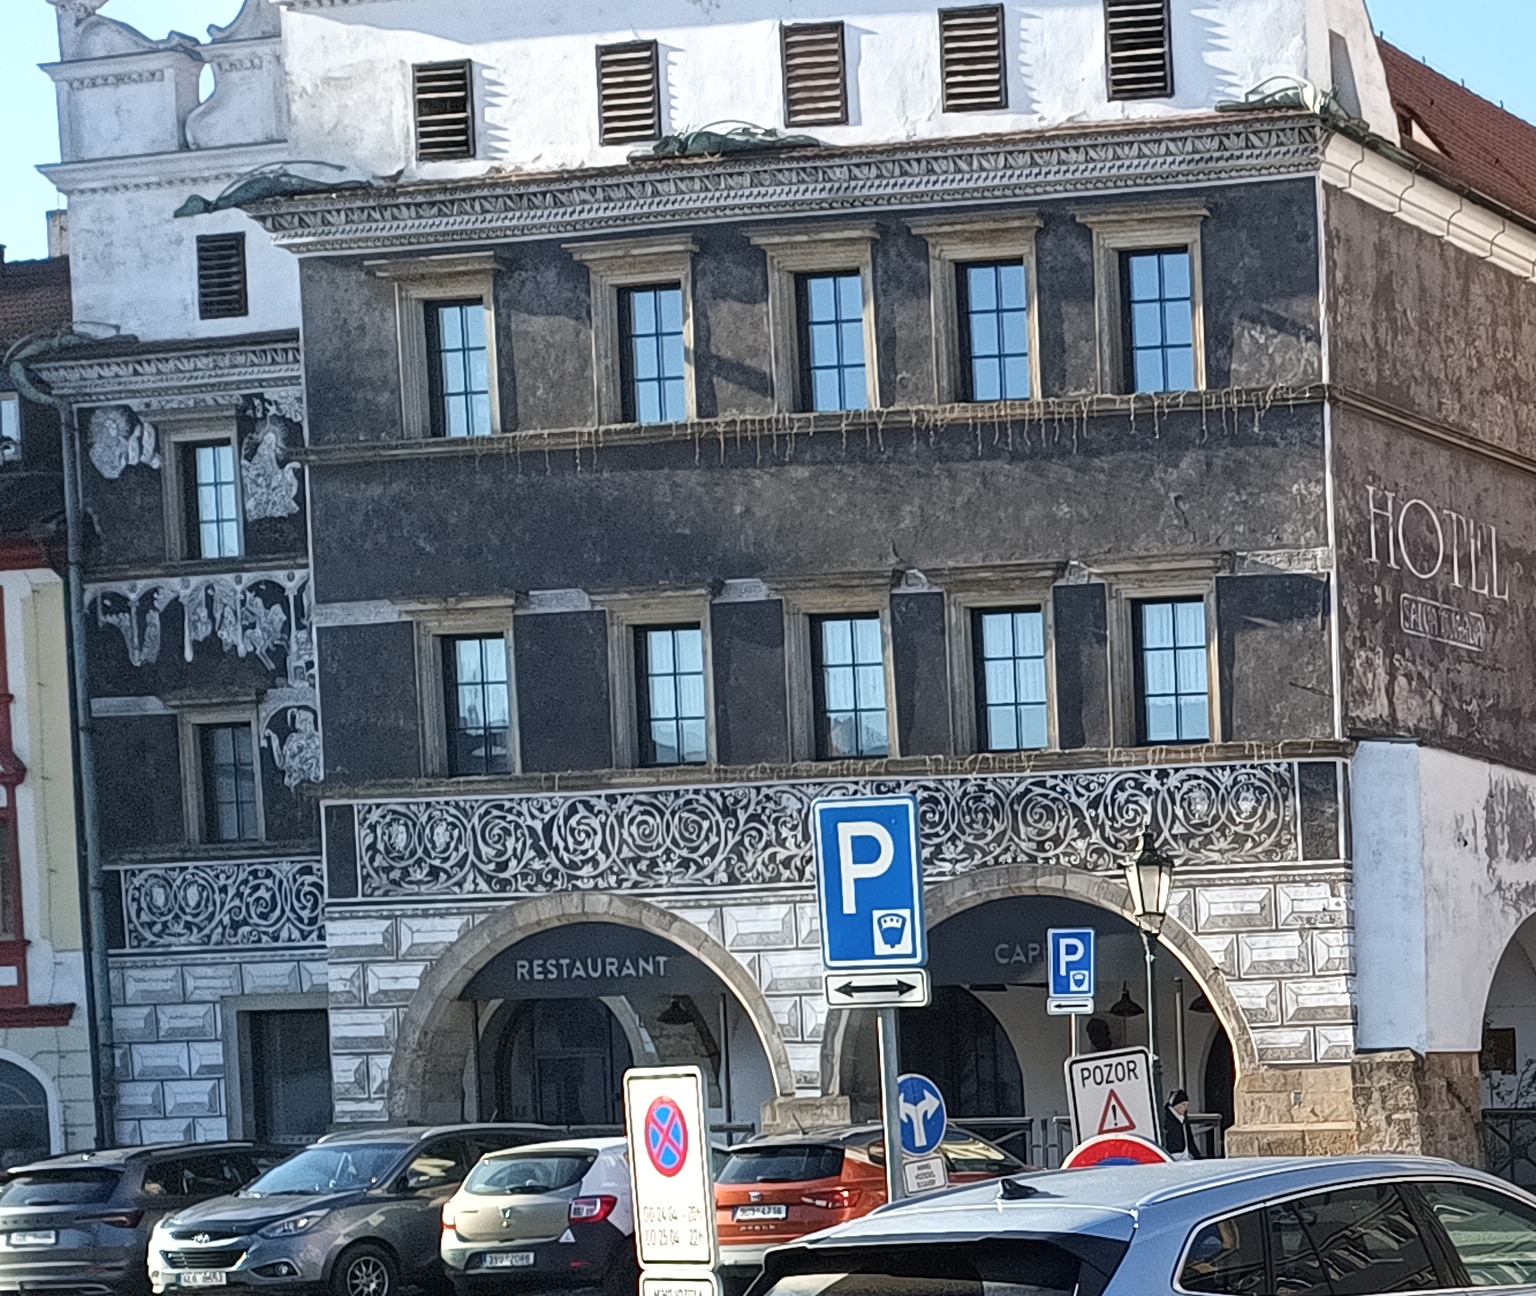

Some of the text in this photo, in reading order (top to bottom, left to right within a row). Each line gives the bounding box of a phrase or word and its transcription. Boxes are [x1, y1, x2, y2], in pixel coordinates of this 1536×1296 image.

[1365, 485, 1509, 604] HOTEL
[837, 821, 895, 914] P
[516, 955, 668, 981] RESTAURANT
[1059, 938, 1085, 976] P
[1080, 1060, 1139, 1089] POZOR
